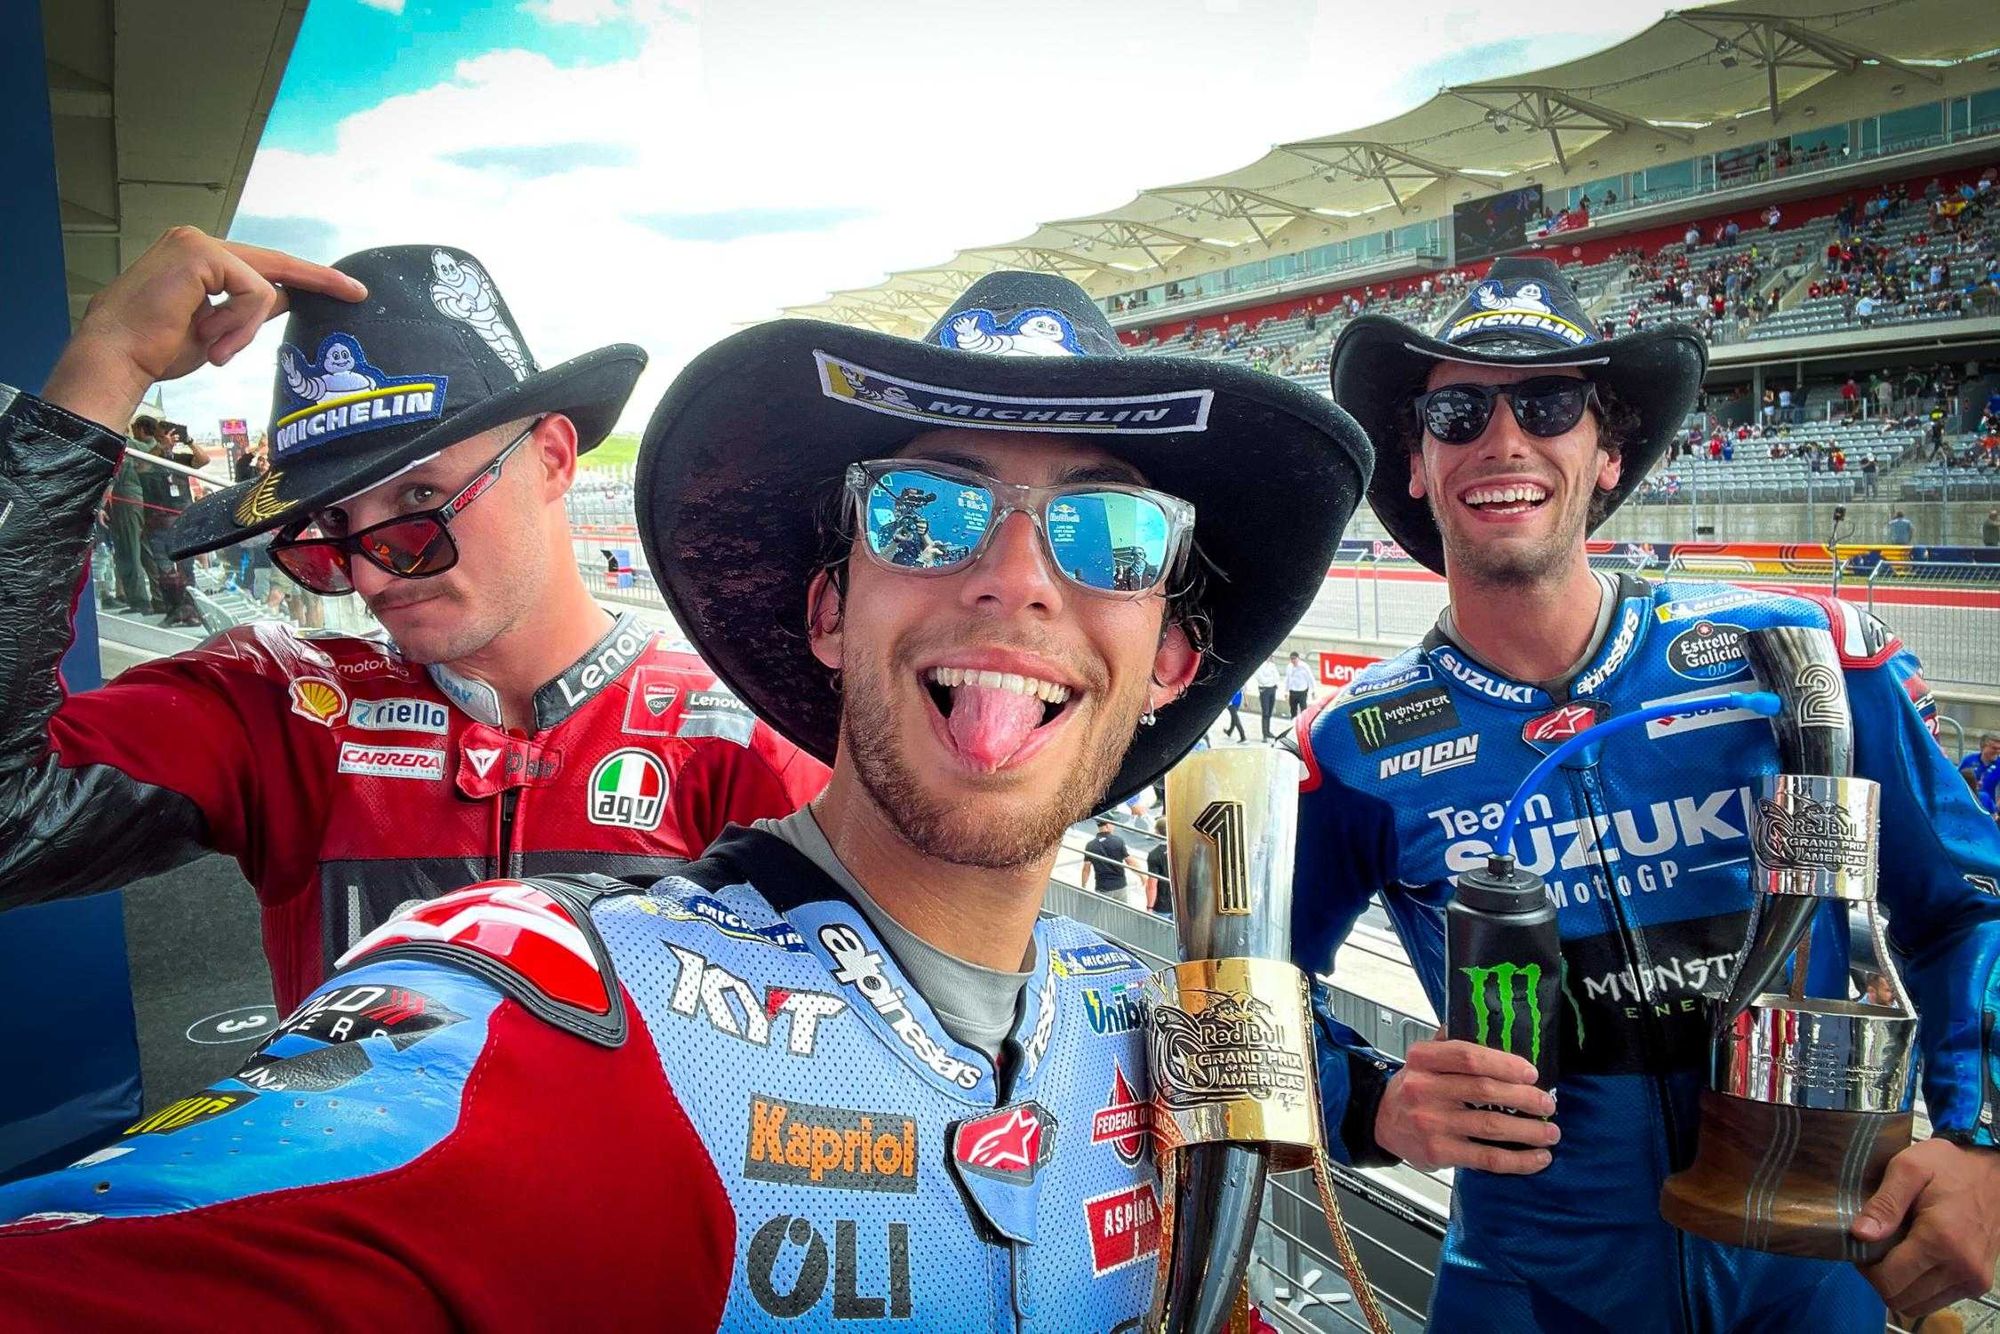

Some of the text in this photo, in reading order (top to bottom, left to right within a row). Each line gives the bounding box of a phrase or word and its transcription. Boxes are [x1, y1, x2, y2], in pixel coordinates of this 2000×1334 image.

[1446, 312, 1584, 346] MICHELIN
[276, 391, 434, 452] MICHELIN
[927, 400, 1171, 423] MICHELIN
[1576, 607, 1640, 696] alpinestars
[1685, 645, 1742, 668] Galicia
[1439, 652, 1535, 704] SUZUKI
[1384, 694, 1450, 721] MONSTER
[1796, 663, 1844, 729] 2
[375, 702, 446, 728] riello
[342, 750, 443, 770] CARRERA
[1379, 733, 1479, 780] NOLAN
[598, 793, 656, 825] agv
[1428, 793, 1554, 840] Team
[1192, 800, 1252, 915] 1
[1789, 837, 1867, 851] GRAND PRIX
[1803, 851, 1868, 866] AMERICAS
[1582, 953, 1740, 1001] MONST
[1201, 1021, 1286, 1046] Red Bull
[1200, 1050, 1302, 1071] GRAND PRIX
[1218, 1072, 1306, 1092] AMERICAS
[1096, 1109, 1138, 1136] FEDERAL
[750, 1100, 916, 1182] Kapriol
[1104, 1196, 1155, 1238] ASPIRA
